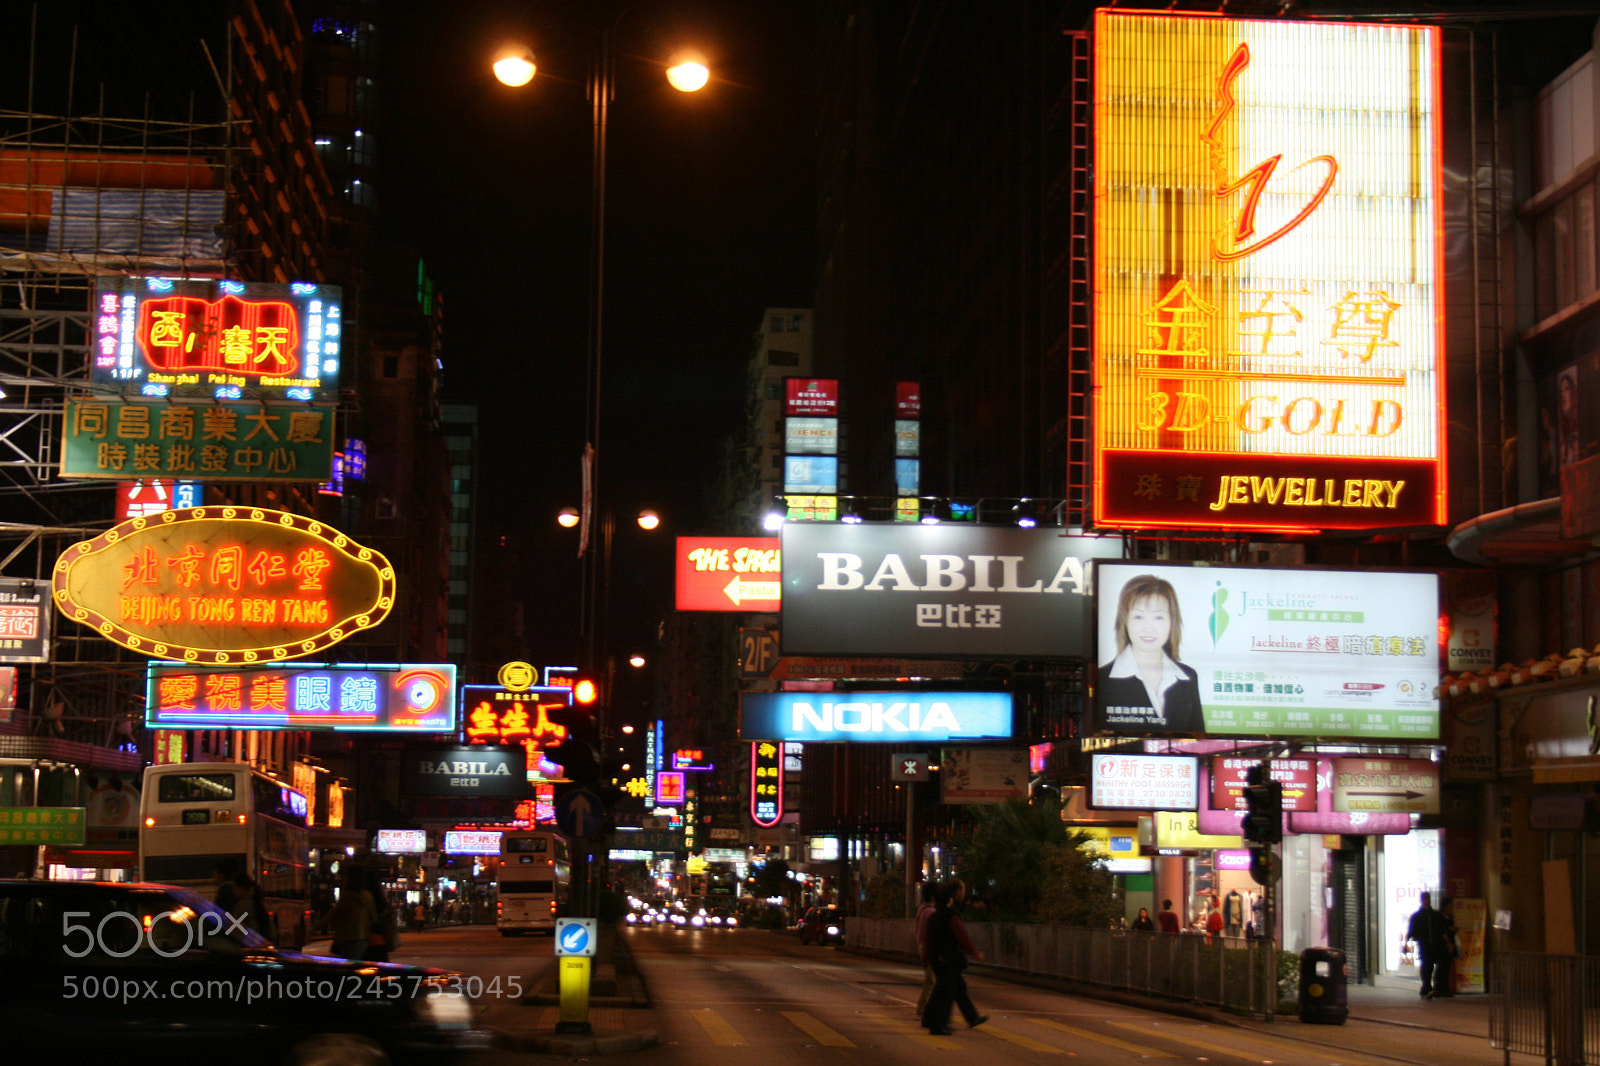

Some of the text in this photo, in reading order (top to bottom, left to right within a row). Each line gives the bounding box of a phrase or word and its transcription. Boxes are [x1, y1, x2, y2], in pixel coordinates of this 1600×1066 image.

[1136, 279, 1404, 364] 金至尊
[148, 373, 199, 385] Shanghai
[260, 376, 320, 388] Restaurant
[73, 404, 324, 444] 同昌商業大廈
[99, 443, 298, 474] 時裝批發中心
[1210, 475, 1405, 511] JEWELLERY
[121, 544, 331, 591] 北京同仁堂
[688, 547, 729, 572] THE
[817, 552, 1092, 595] BABILA
[739, 585, 775, 596] Pasta
[120, 595, 328, 624] BEIJING TONG REN TANG
[916, 604, 1003, 628] 巴比亞
[1237, 591, 1316, 617] Jackeline
[744, 636, 772, 672] 2/F
[1250, 634, 1303, 649] Jackeline
[159, 675, 378, 712] 愛視美眼鏡
[791, 702, 961, 732] NOKIA
[1106, 715, 1167, 726] Jackeline Yang
[419, 761, 512, 776] BABILA
[1120, 759, 1192, 779] 新足保健
[1096, 780, 1192, 788] HEALTHY FOOT MASSAGE
[1169, 818, 1182, 831] In
